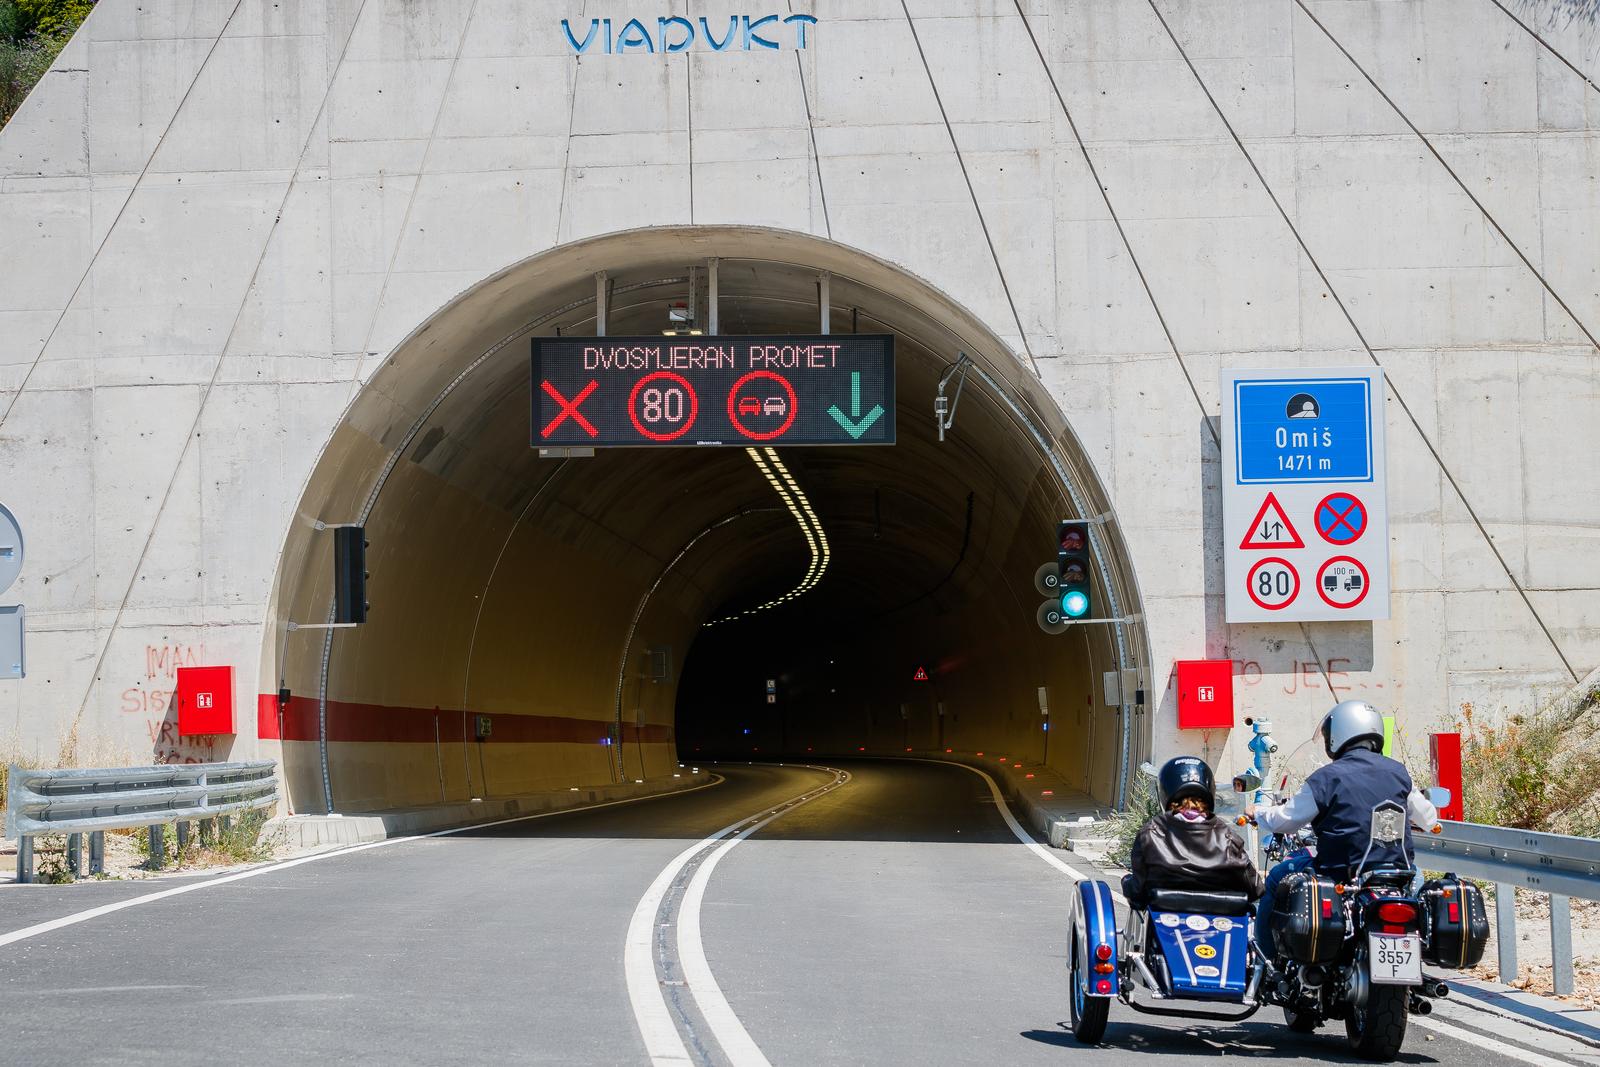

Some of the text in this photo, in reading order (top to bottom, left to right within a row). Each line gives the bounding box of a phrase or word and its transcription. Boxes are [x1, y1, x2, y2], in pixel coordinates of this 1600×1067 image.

[561, 15, 818, 54] VIADUKT
[584, 345, 841, 370] DVOSMJERAN PROMET
[643, 388, 683, 422] 80
[1275, 427, 1332, 448] Omiš
[1278, 455, 1331, 471] 1471 m
[1333, 567, 1346, 576] 100
[1259, 570, 1290, 597] 80
[1379, 936, 1399, 951] ST
[1378, 950, 1412, 965] 3557
[1391, 964, 1400, 978] F
